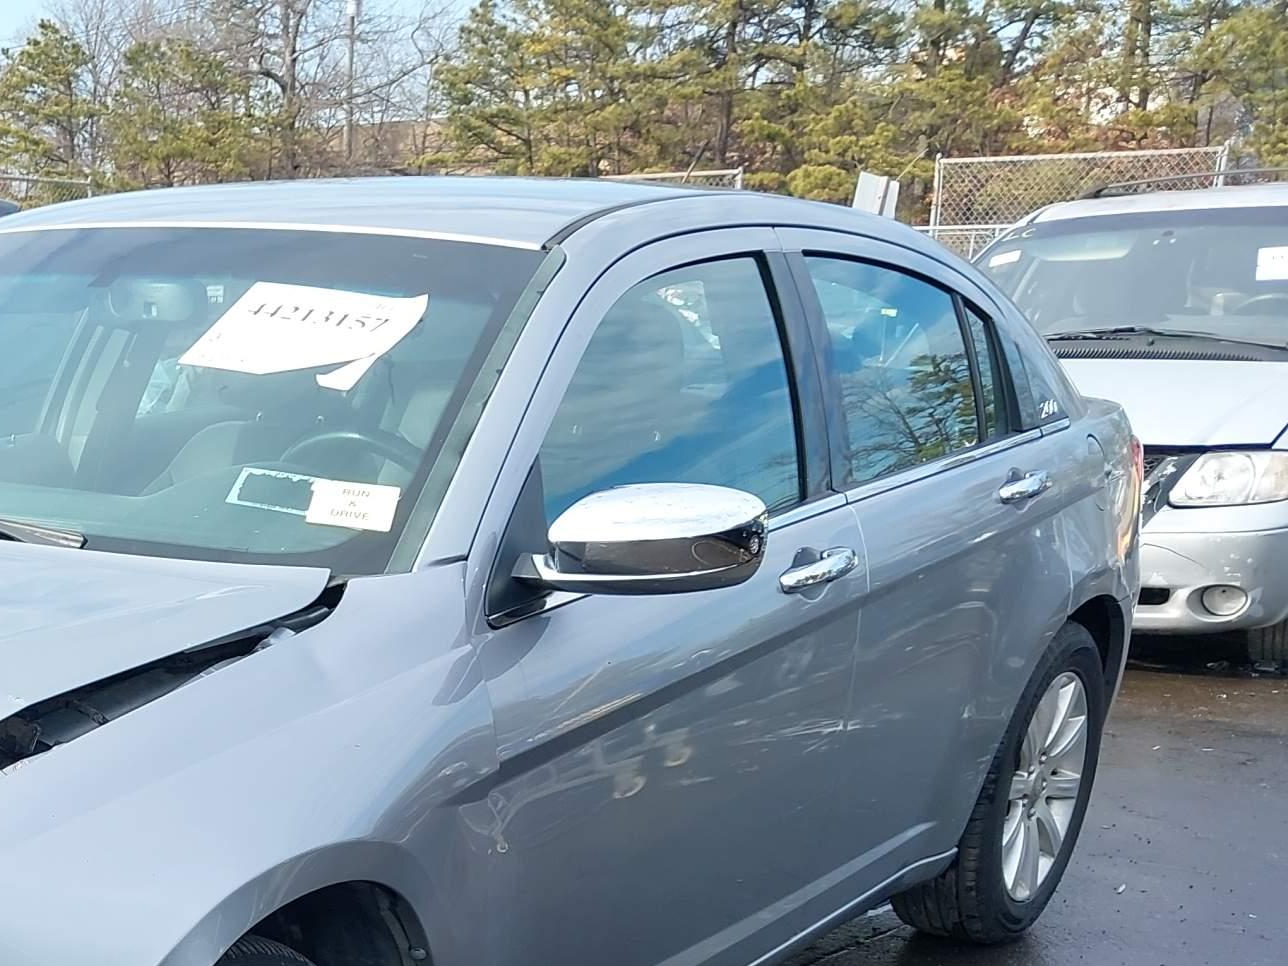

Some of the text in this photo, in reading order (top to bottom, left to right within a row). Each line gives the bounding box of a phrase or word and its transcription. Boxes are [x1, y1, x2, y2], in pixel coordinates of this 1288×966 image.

[247, 303, 391, 333] 44213157
[341, 488, 371, 498] RUN
[330, 508, 370, 521] DRIVE
